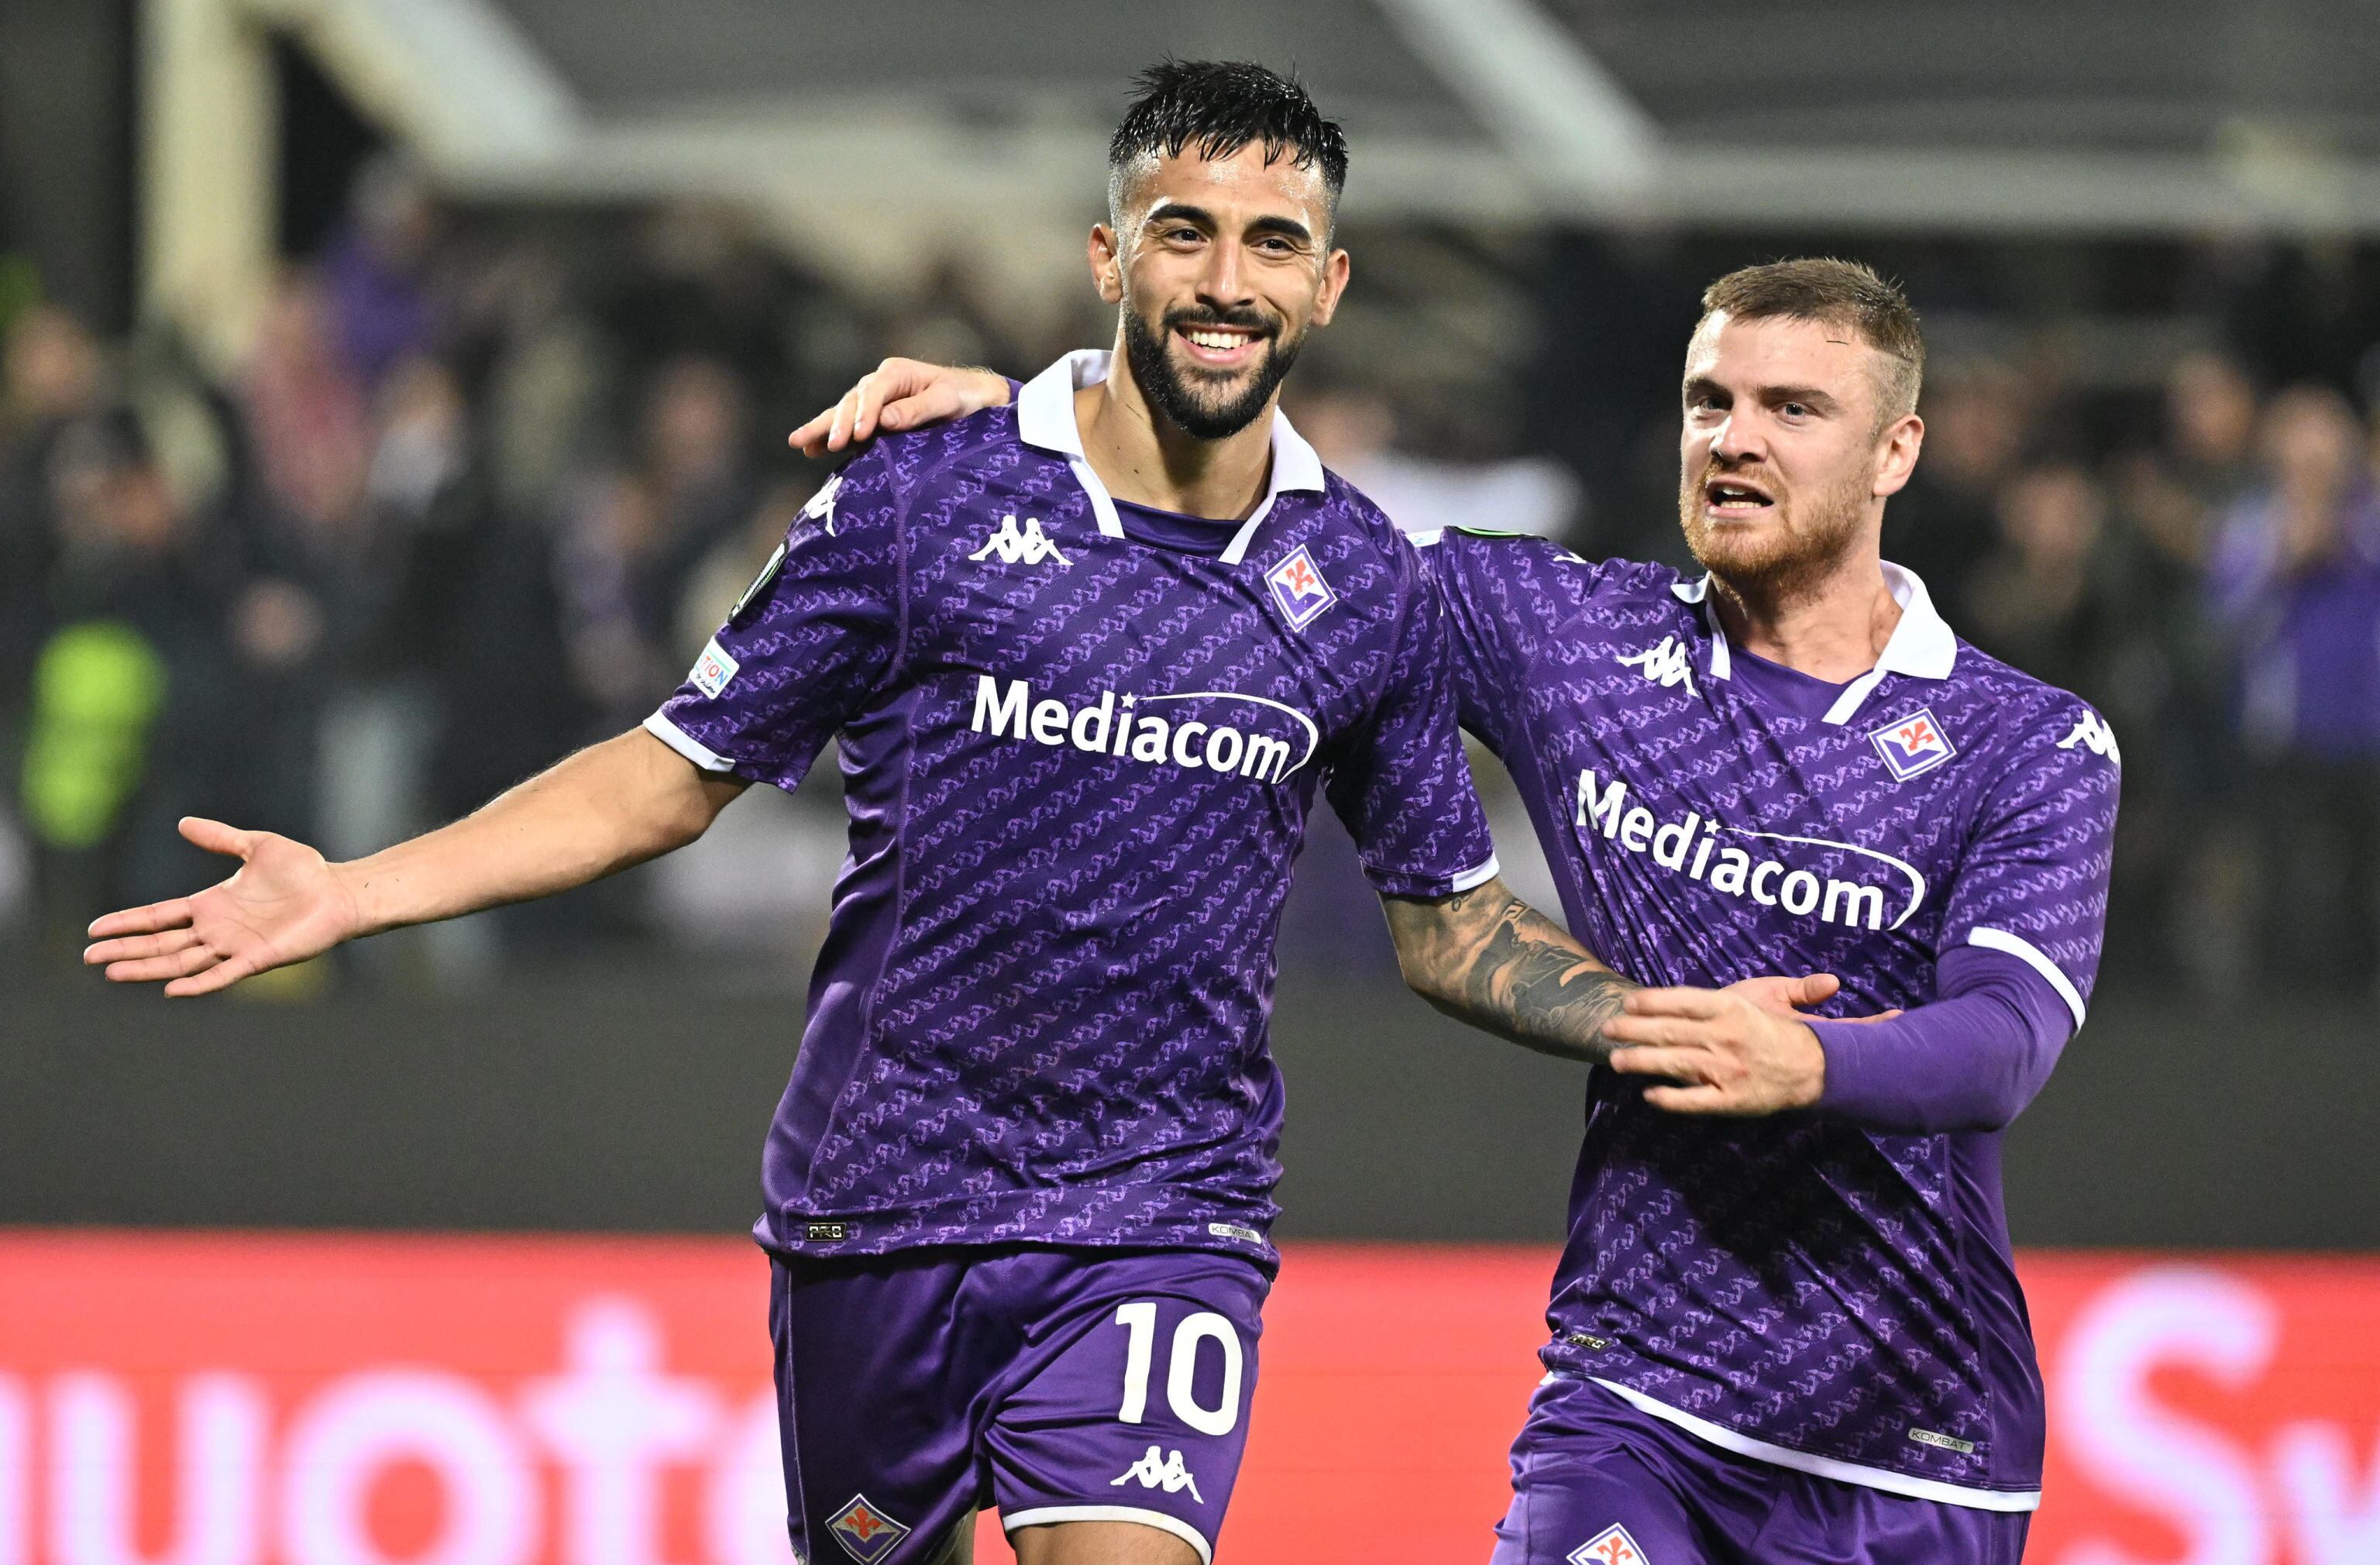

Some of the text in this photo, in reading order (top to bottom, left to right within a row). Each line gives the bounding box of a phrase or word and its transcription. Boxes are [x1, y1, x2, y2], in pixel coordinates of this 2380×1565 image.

[971, 675, 1291, 785] Mediacom
[1576, 769, 1885, 930] Mediacom
[0, 1290, 803, 1565] uot
[1115, 1302, 1243, 1436] 10
[1911, 1430, 1968, 1450] KOMBAT
